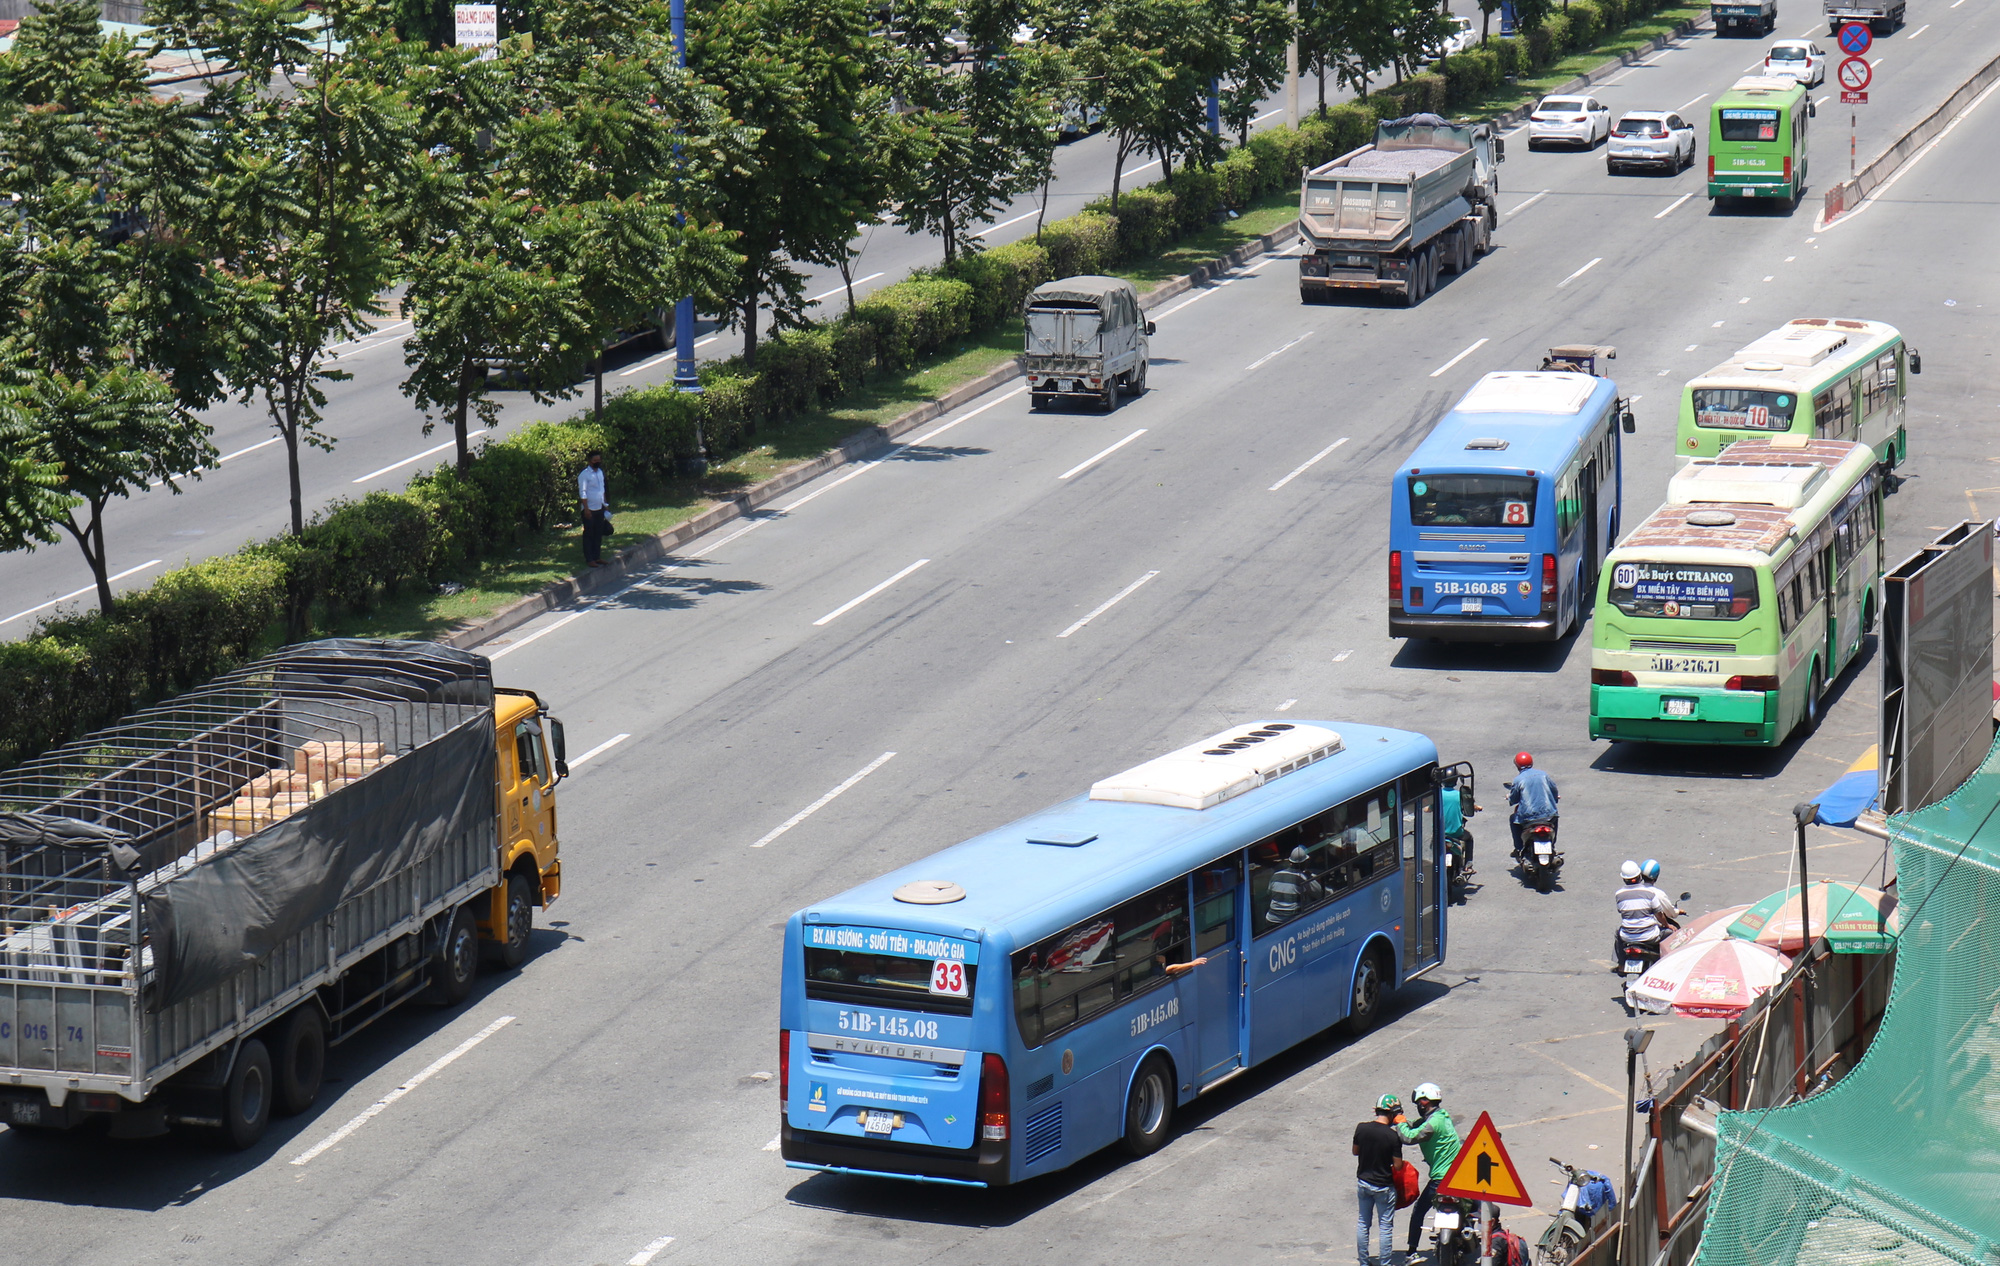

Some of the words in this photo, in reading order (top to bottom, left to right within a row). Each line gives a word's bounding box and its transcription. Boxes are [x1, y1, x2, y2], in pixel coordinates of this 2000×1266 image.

[479, 11, 495, 24] LONG
[1760, 126, 1774, 137] 76
[1750, 407, 1768, 426] 10
[1507, 504, 1524, 524] 8
[1618, 569, 1635, 583] 601
[1638, 569, 1650, 580] Xe
[1651, 569, 1674, 582] Buýt
[1675, 571, 1733, 582] CITRANCO
[1434, 582, 1507, 594] 51B-160.85
[1637, 585, 1647, 593] BX
[1648, 582, 1665, 594] MIỀN
[1666, 584, 1680, 595] TÂY
[1685, 587, 1695, 596] BX
[1697, 586, 1714, 596] BIÊN
[1714, 586, 1729, 597] HÒA
[813, 928, 824, 943] BX
[824, 929, 836, 945] AN
[837, 928, 863, 948] SƯƠNG
[869, 931, 887, 951] SUỐI
[889, 934, 908, 953] TIÊN
[951, 943, 965, 960] GIA
[1269, 936, 1296, 973] CNG
[936, 963, 962, 991] 33
[1642, 975, 1677, 993] VEDAN
[838, 1010, 939, 1040] 51B-145.08
[1130, 997, 1179, 1037] 51B-145.08
[24, 1023, 48, 1041] 016
[67, 1026, 83, 1042] 74
[835, 1039, 934, 1060] HYUNDAI
[872, 1111, 888, 1122] 51B
[866, 1121, 893, 1133] 145.08
